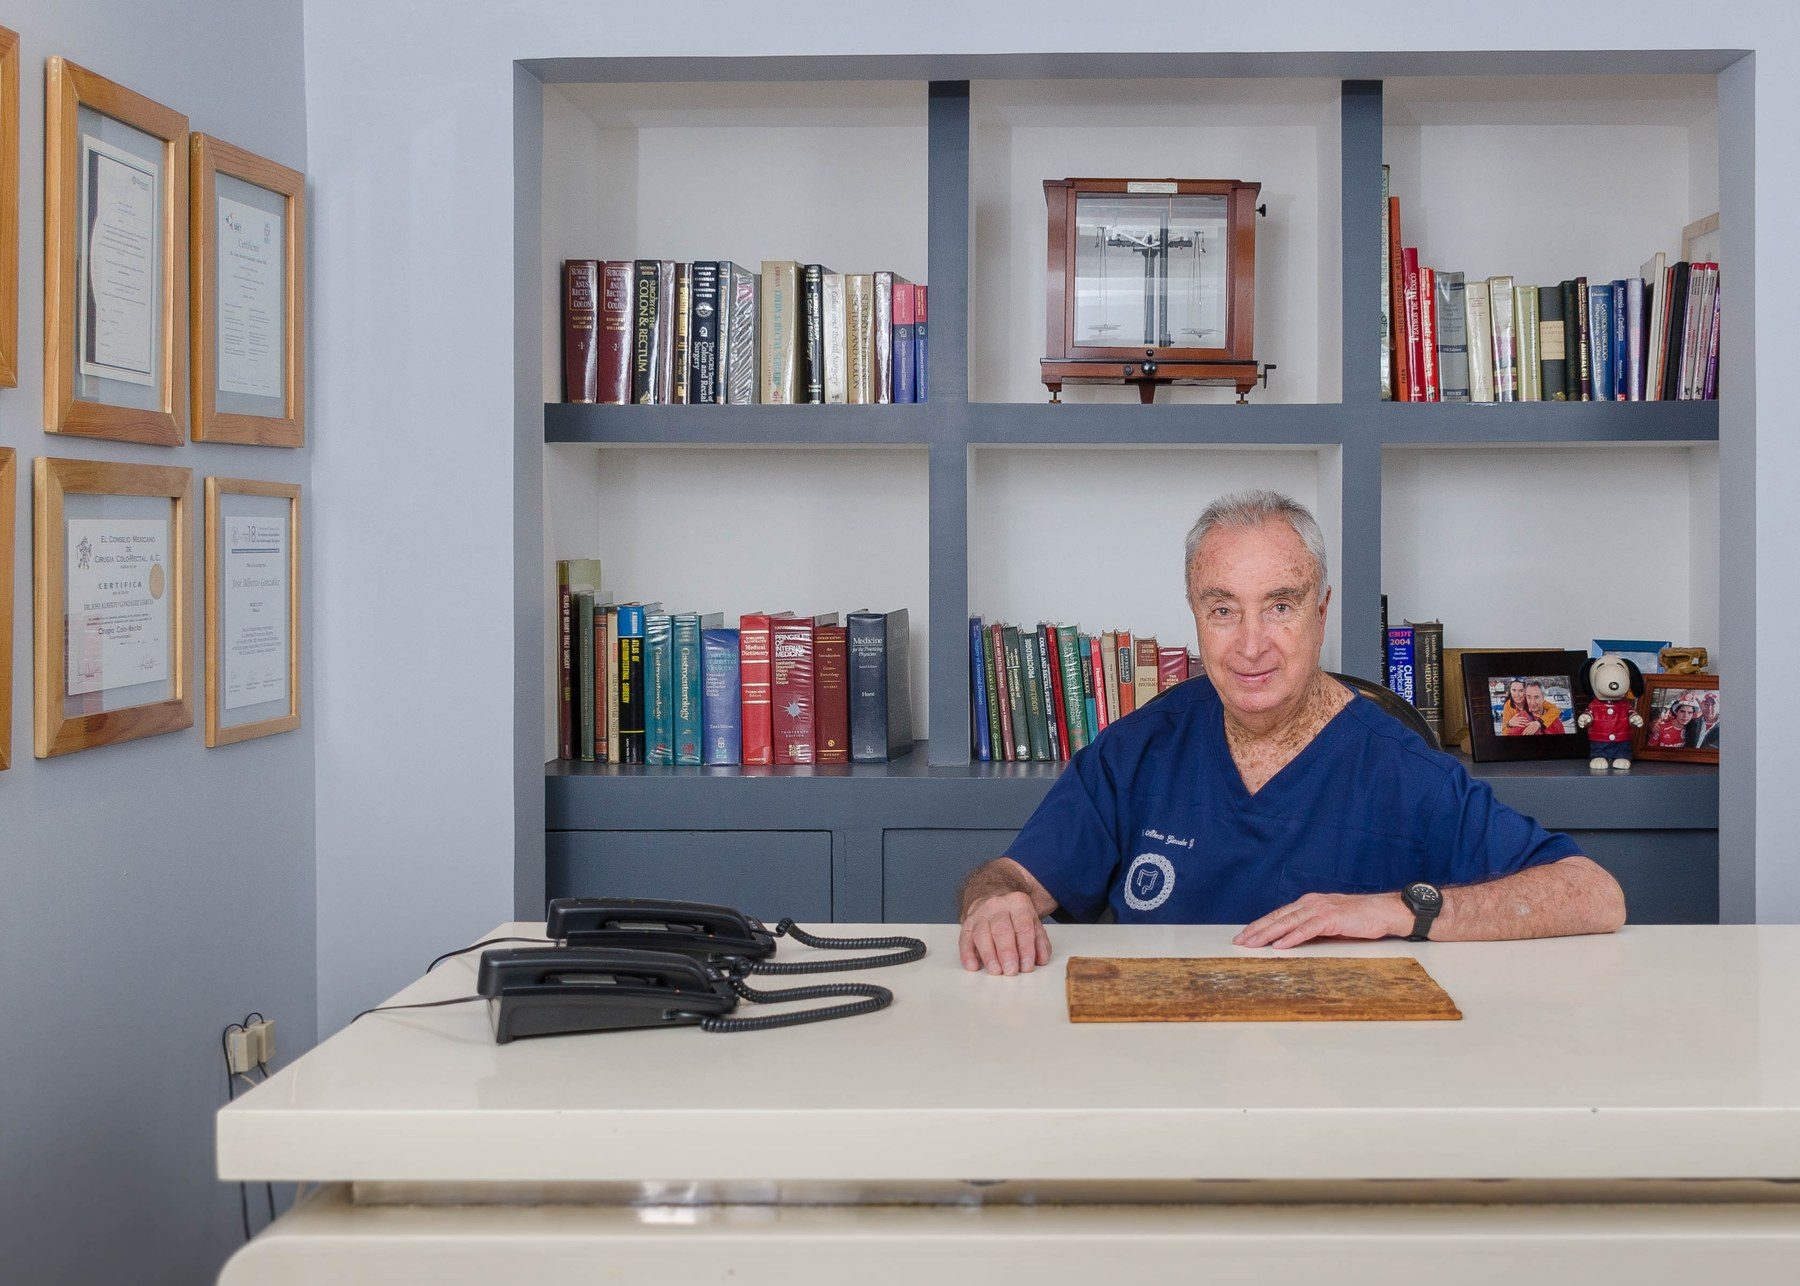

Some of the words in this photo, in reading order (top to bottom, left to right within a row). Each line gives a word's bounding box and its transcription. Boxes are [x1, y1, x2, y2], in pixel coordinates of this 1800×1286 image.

[639, 279, 648, 316] COLON
[639, 316, 648, 327] &
[638, 328, 648, 372] RECTUM
[693, 341, 701, 370] Surgery
[700, 341, 709, 363] Colon
[1580, 343, 1588, 378] ANIMALES
[700, 364, 708, 379] and
[828, 355, 840, 386] Surgery
[852, 357, 860, 389] COLON
[700, 379, 709, 403] Rectal
[708, 395, 715, 403] of
[247, 525, 257, 543] 18
[98, 581, 142, 590] CERTIFICA
[631, 639, 640, 654] ATLAS
[852, 637, 883, 645] Medicine
[1389, 638, 1411, 646] 2004
[563, 649, 571, 669] SURGERY
[622, 639, 630, 680] GASTROINTESTINAL
[1025, 638, 1035, 679] PROCTOLOGIE
[1389, 665, 1396, 673] &
[681, 647, 690, 720] Gastroenterology
[1082, 660, 1091, 694] PROCTOLOGY
[622, 682, 630, 704] SURGERY
